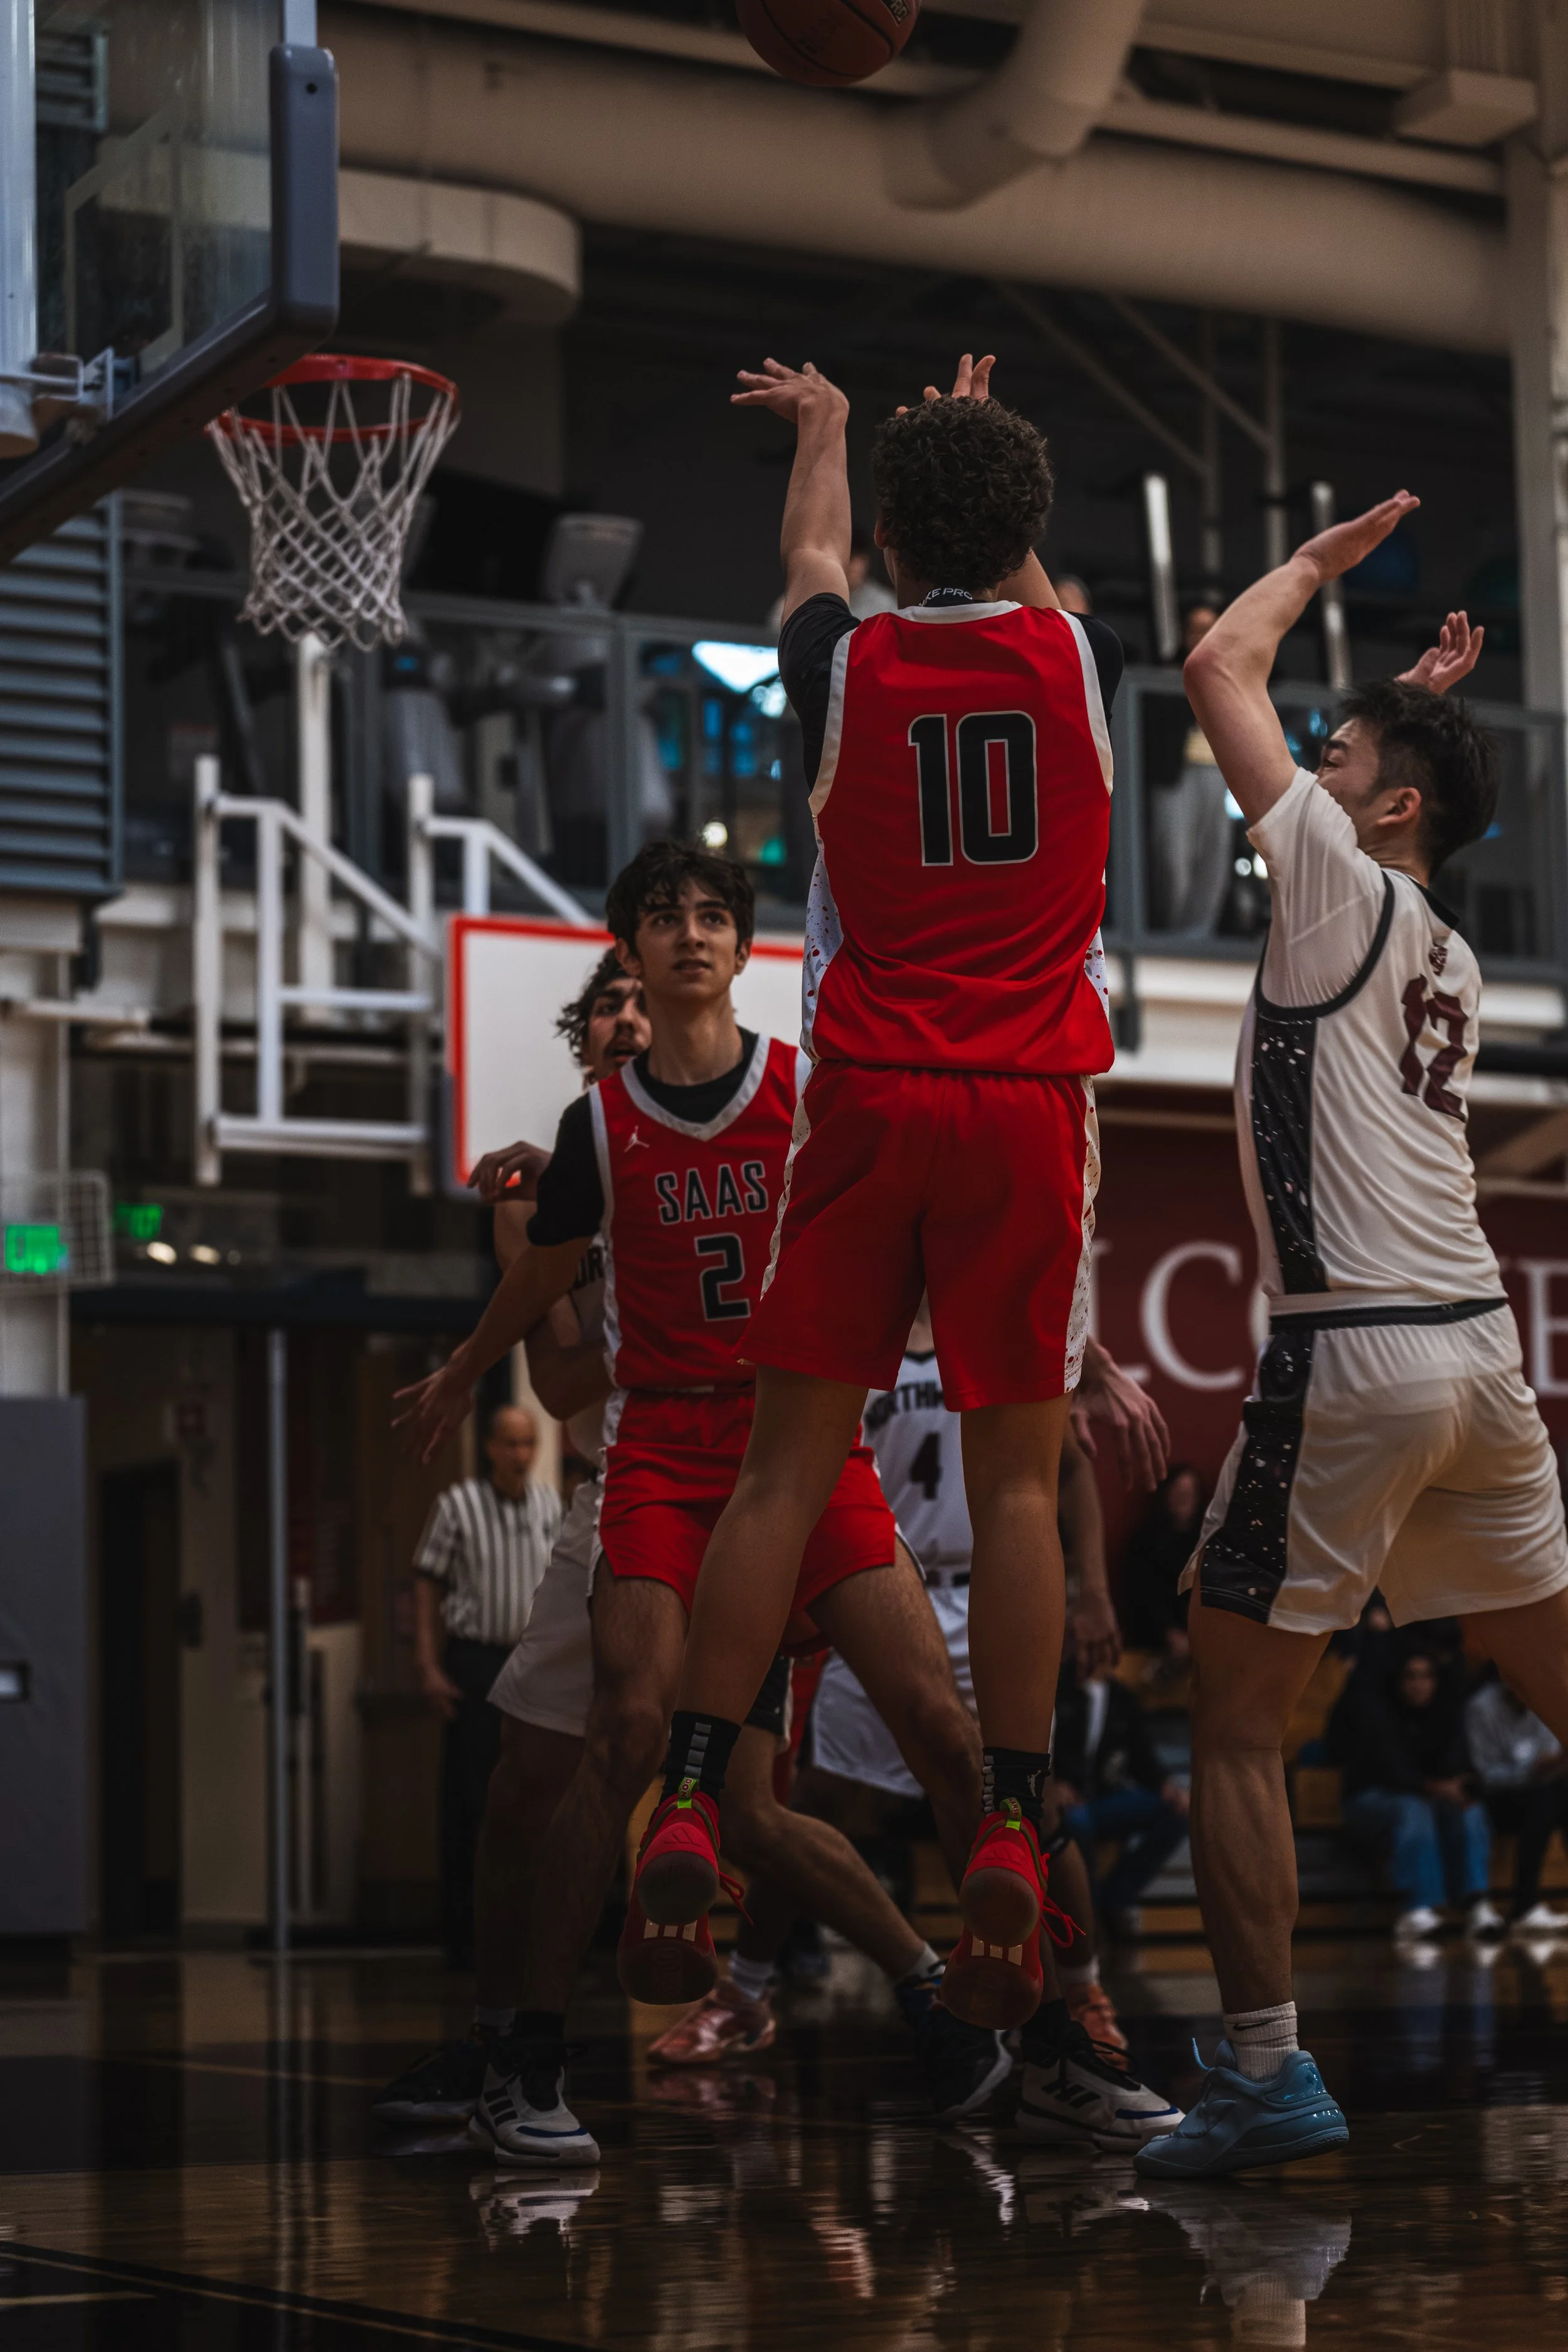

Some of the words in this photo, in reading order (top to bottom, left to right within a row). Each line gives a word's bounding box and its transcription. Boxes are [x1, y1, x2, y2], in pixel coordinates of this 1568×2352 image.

[908, 709, 1039, 866] 10
[1401, 973, 1469, 1123] 12
[654, 1160, 769, 1226] SAAS
[694, 1232, 751, 1322] 2
[910, 1432, 943, 1501] 4
